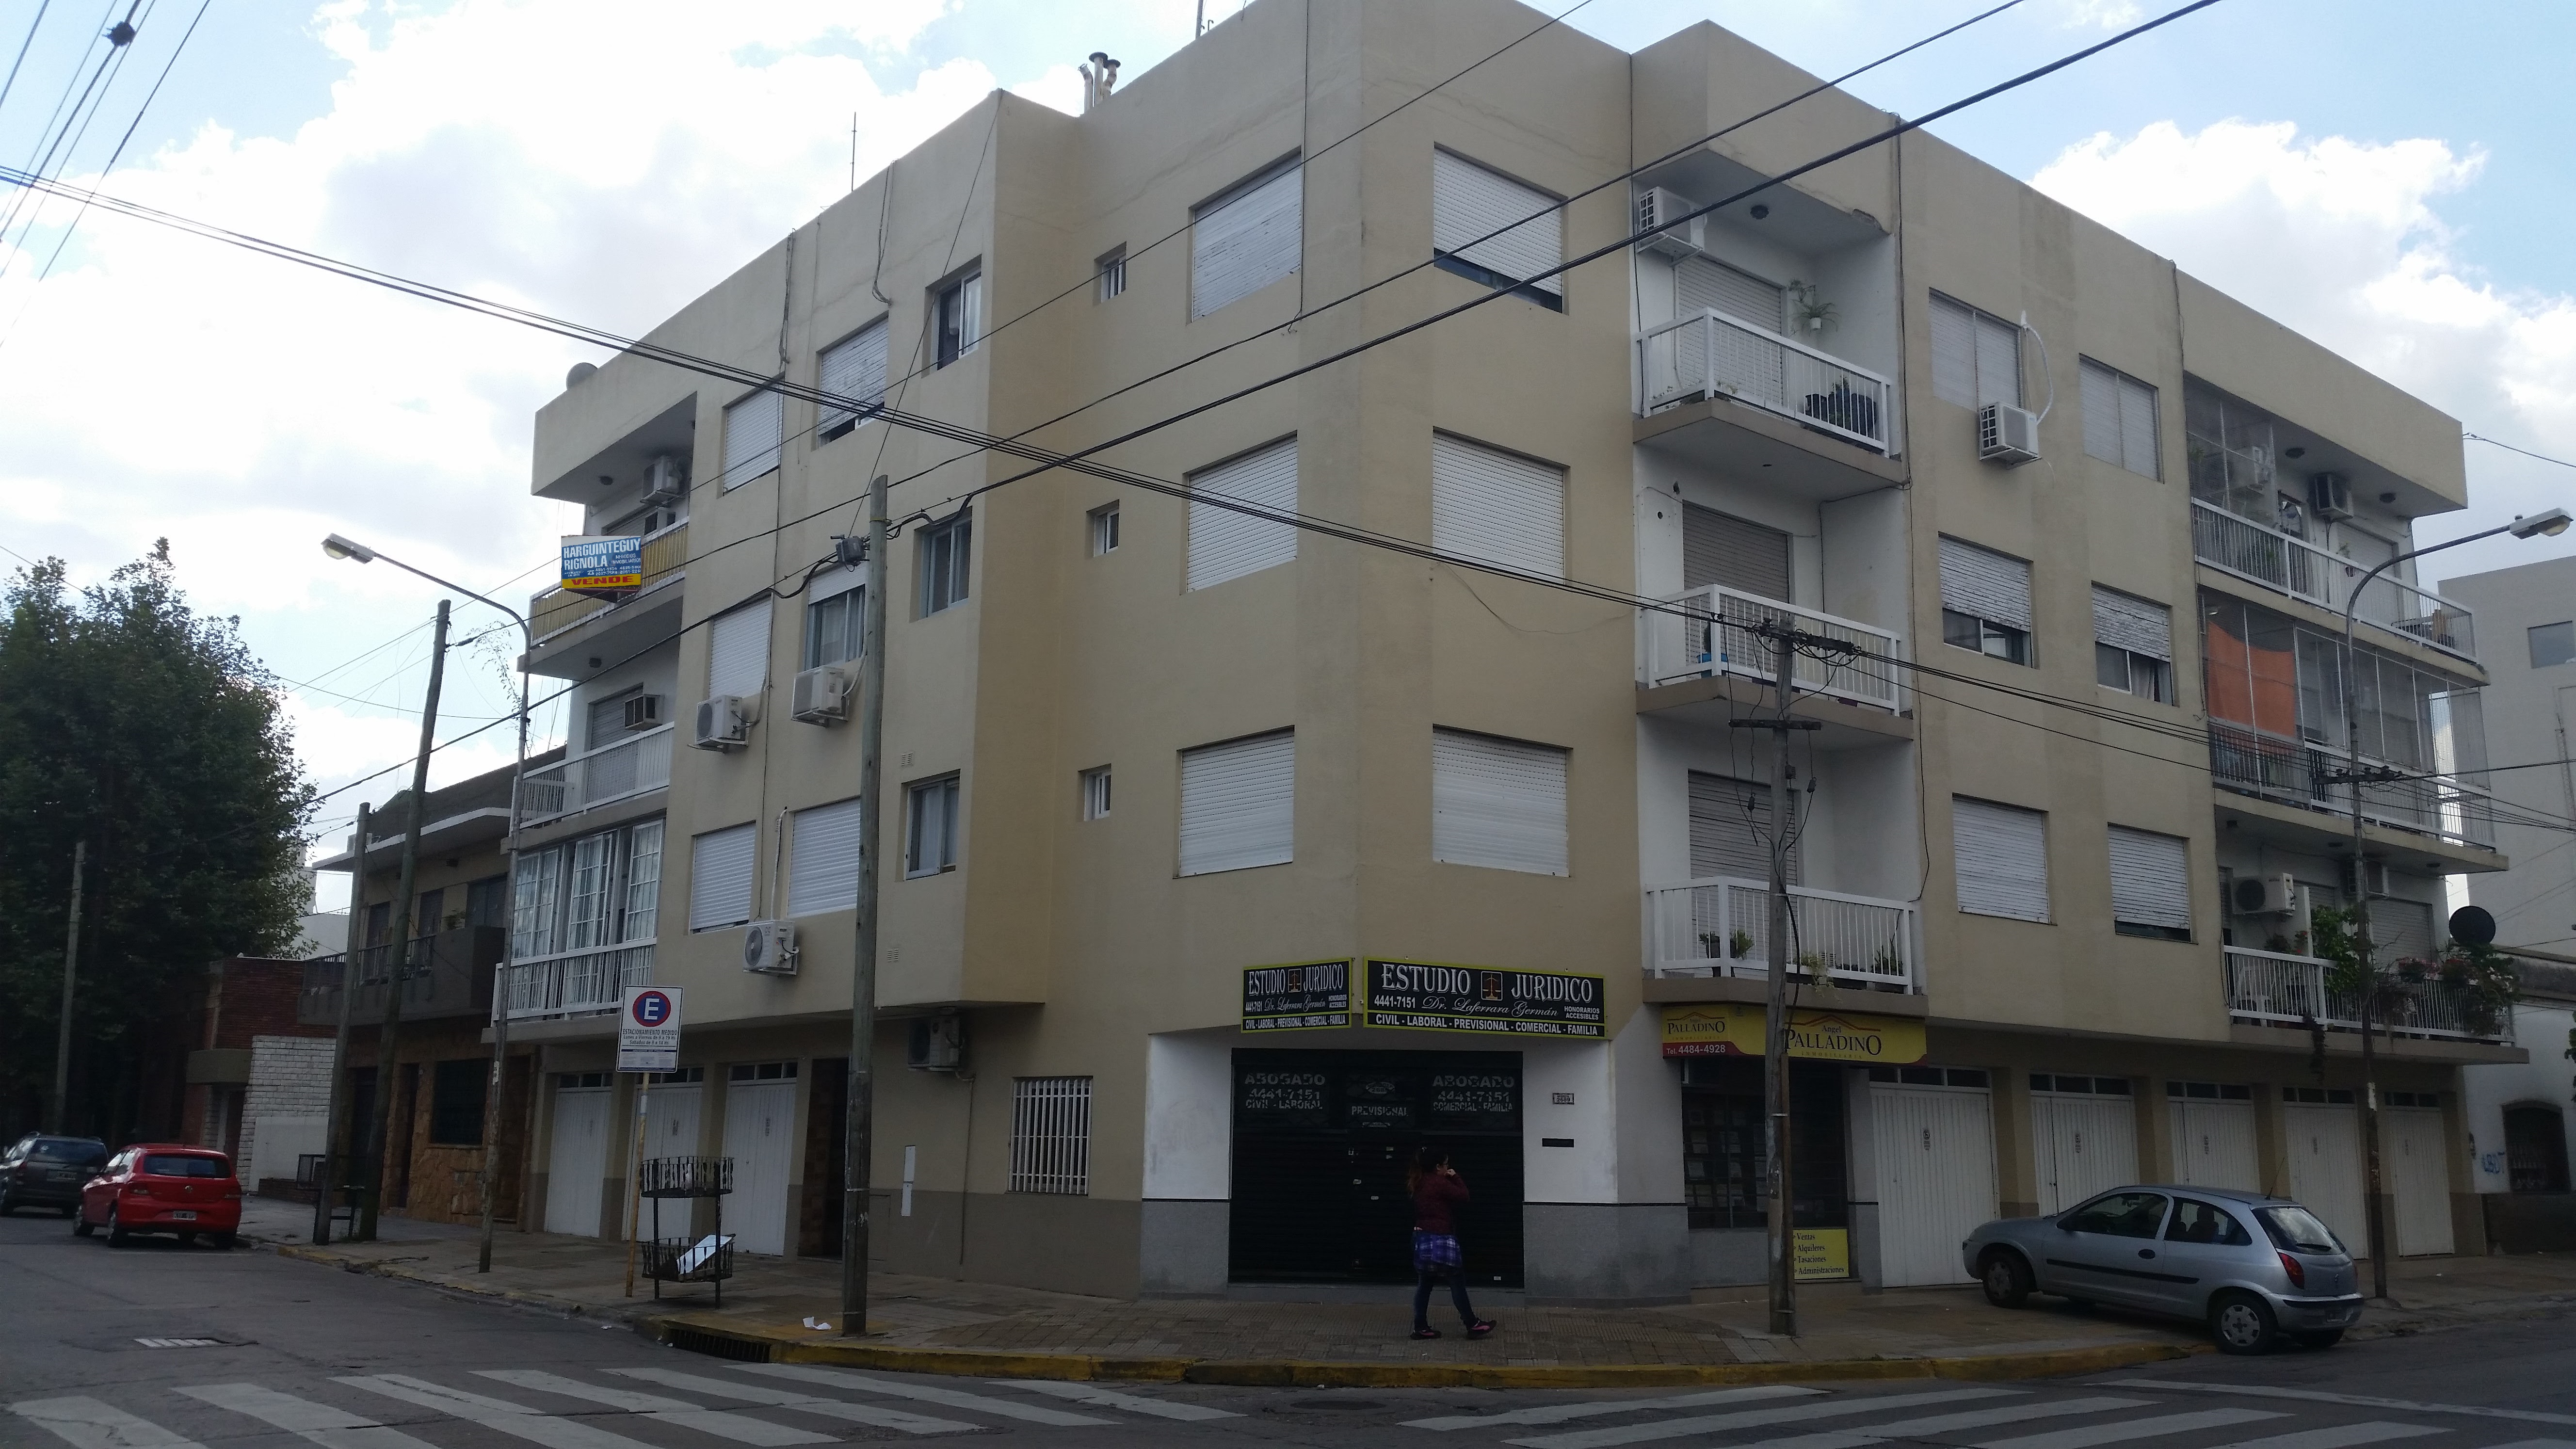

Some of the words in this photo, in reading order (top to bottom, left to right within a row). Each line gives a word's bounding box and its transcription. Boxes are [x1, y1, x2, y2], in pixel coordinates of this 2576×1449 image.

[564, 538, 640, 558] HARGUINTEGUY
[564, 555, 608, 570] RIGNOLA
[571, 576, 633, 585] VENDE
[1249, 969, 1285, 996] ESTUDIO
[1304, 964, 1343, 992] JURIDICO
[1381, 963, 1471, 995] ESTUDIO
[1511, 974, 1593, 1003] JURIDICO
[644, 998, 660, 1020] E
[1245, 1001, 1262, 1012] 4441-7151
[1264, 998, 1275, 1011] Dr.
[1277, 997, 1303, 1014] Laferrara
[1303, 994, 1325, 1012] Germán
[1374, 995, 1416, 1009] 4441-7151
[1421, 996, 1447, 1010] Dr.
[1451, 997, 1510, 1015] Laferrara
[1511, 1000, 1558, 1017] Germán
[1245, 1020, 1255, 1029] CIVIL
[1258, 1018, 1275, 1029] LABORAL
[1277, 1017, 1302, 1027] PREVISIONAL
[1304, 1016, 1327, 1026] COMERCIAL
[1330, 1014, 1346, 1024] FAMILIA
[1376, 1014, 1400, 1025] CIVIL
[1407, 1015, 1447, 1028] LABORAL
[1454, 1018, 1509, 1031] PREVISIONAL
[1515, 1022, 1562, 1034] COMERCIAL
[1567, 1024, 1598, 1036] FAMILIA
[1667, 1021, 1725, 1034] PALLADINO
[1822, 1025, 1842, 1033] Angel
[1783, 1028, 1882, 1056] PALLADINO
[1678, 1044, 1726, 1054] 4484-4928
[1244, 1073, 1325, 1085] ABOGADO
[1433, 1075, 1515, 1088] ABOGADO
[1438, 1091, 1509, 1102] 4441-7151
[1246, 1099, 1268, 1109] CIVIL
[1433, 1102, 1477, 1111] COMERCIAL
[1798, 1244, 1825, 1254] Alquileres
[1797, 1255, 1826, 1263] Tasaciones
[1799, 1266, 1844, 1274] Administraciones
